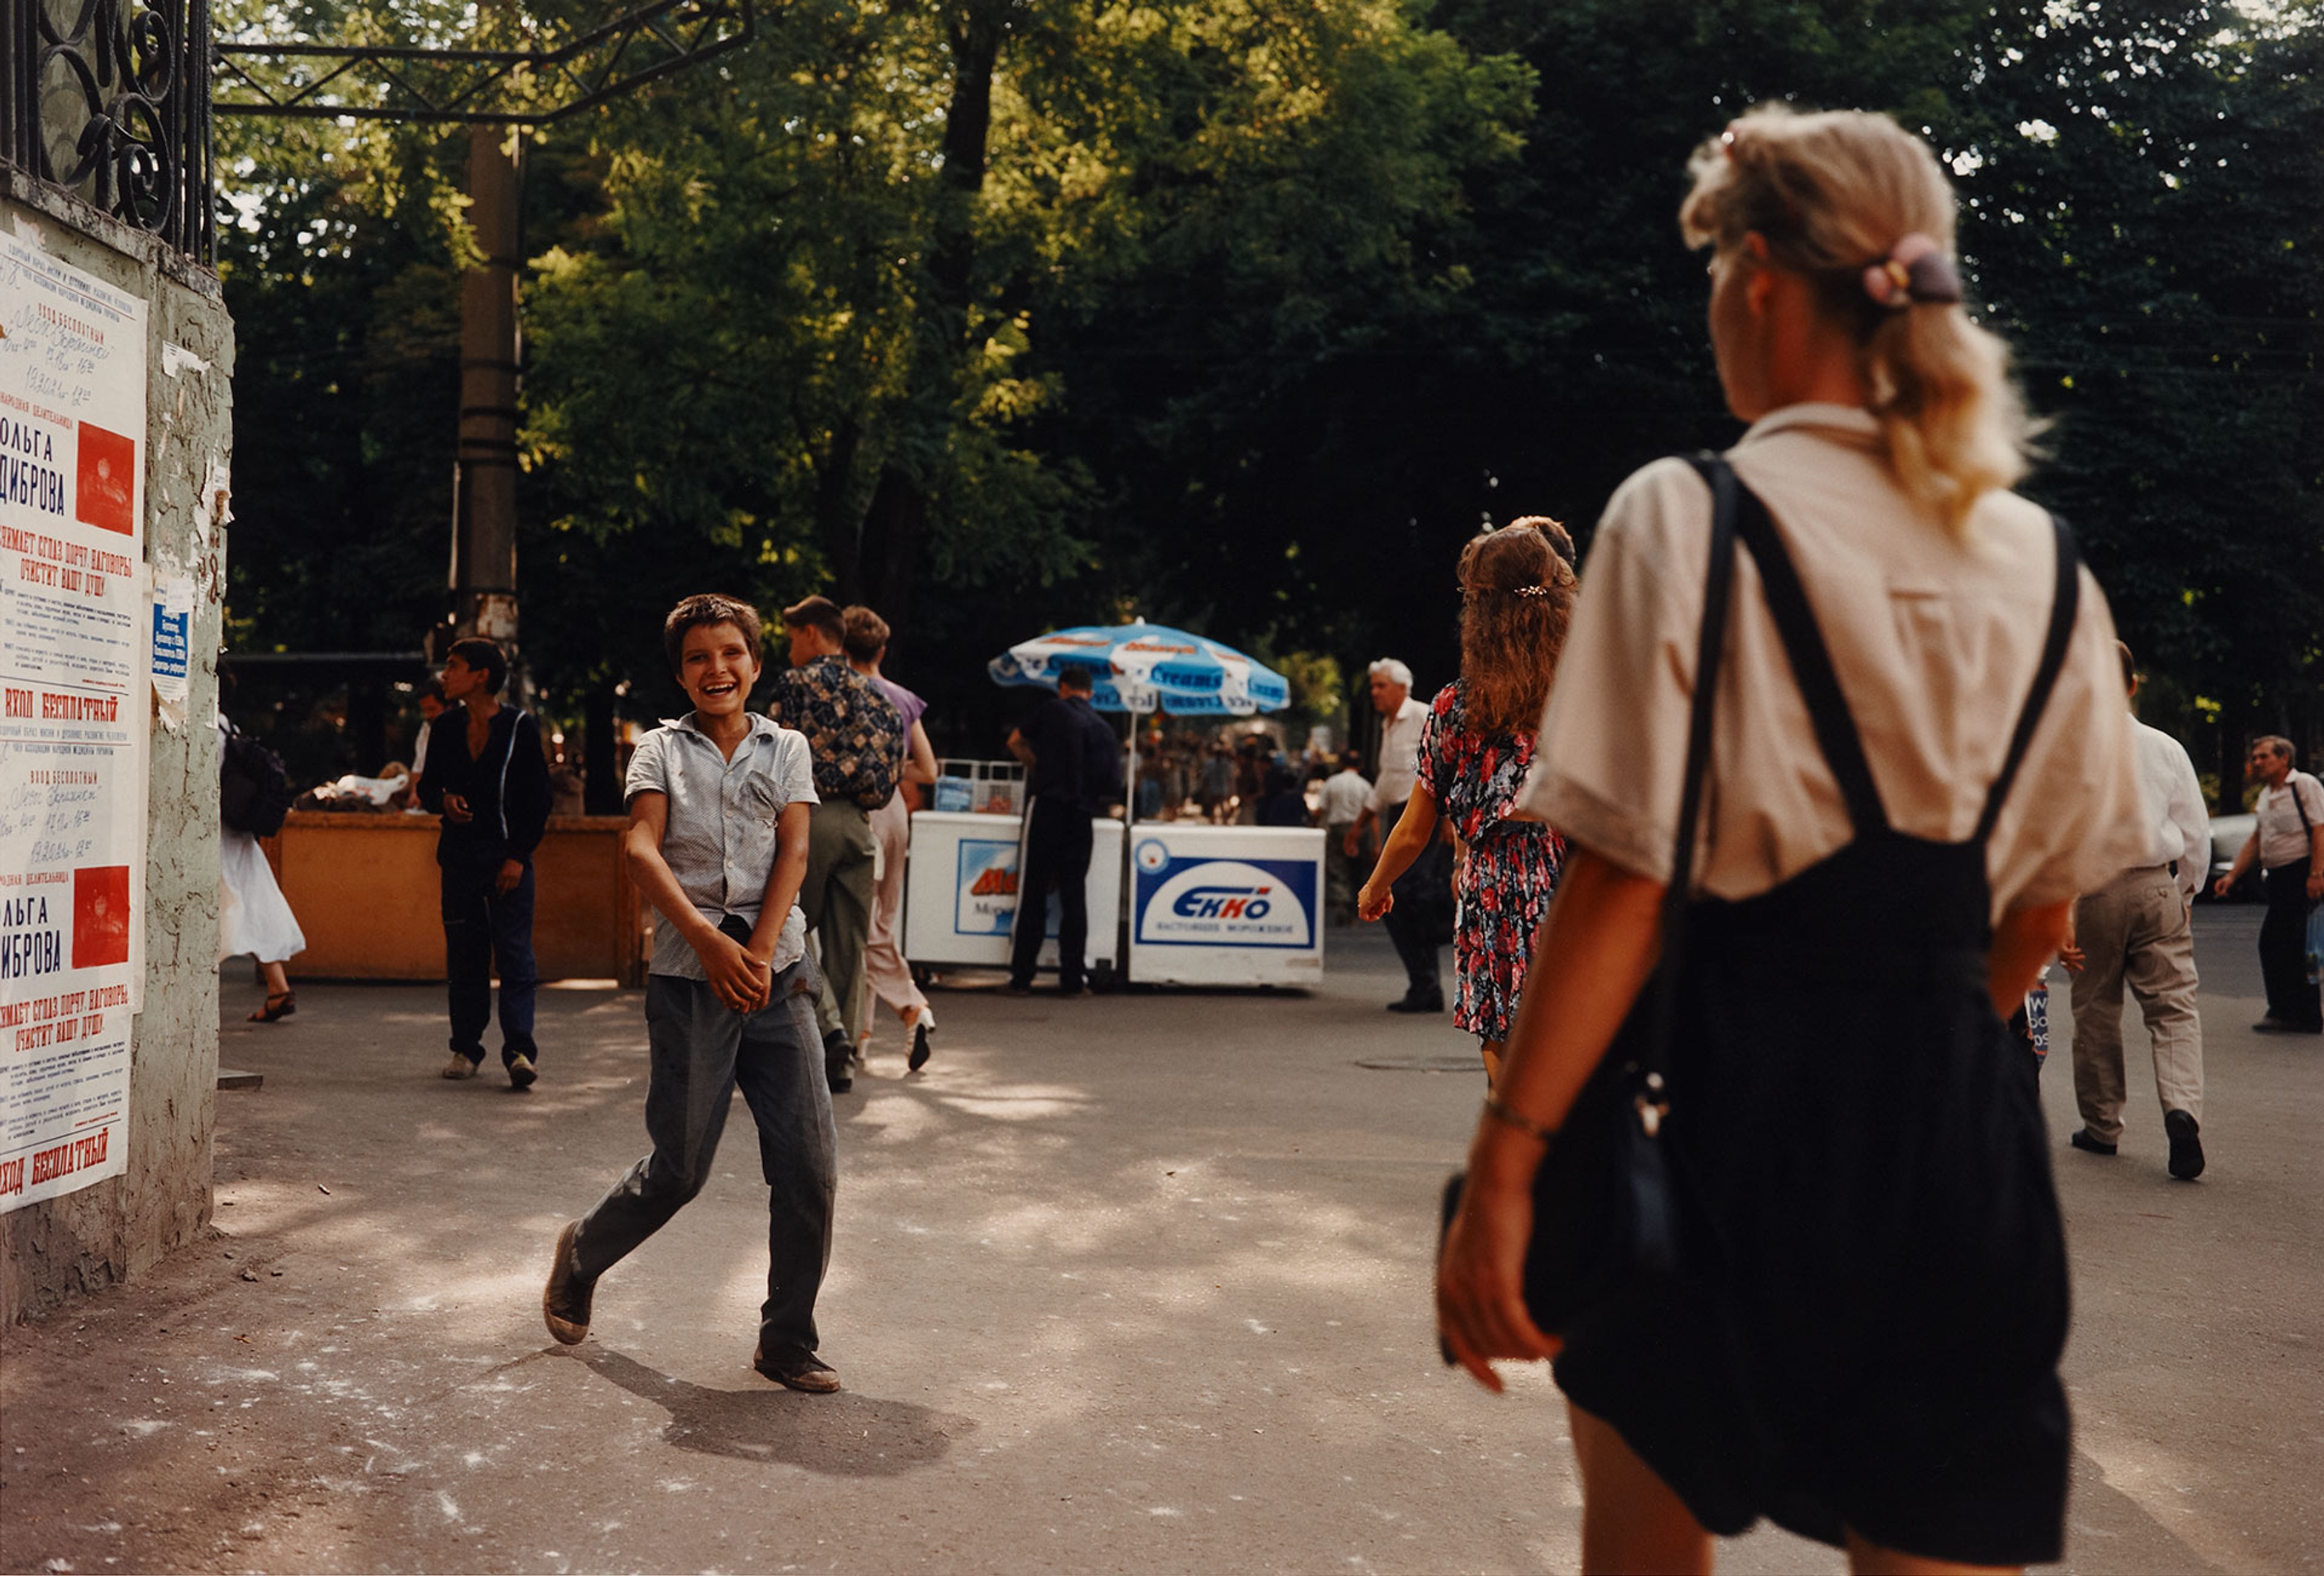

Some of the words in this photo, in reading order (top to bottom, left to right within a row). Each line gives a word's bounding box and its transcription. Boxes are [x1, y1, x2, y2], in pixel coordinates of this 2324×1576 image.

[38, 303, 56, 325] ВХОД
[59, 312, 104, 345] БЕСПЛАТНЫЙ
[0, 417, 52, 462] ОЛЬГА
[0, 454, 65, 516] ДИБРОВА
[62, 568, 82, 592] ВАШУ
[5, 688, 34, 718] ВХОД
[42, 692, 118, 722] БЕСПЛАТНЫЙ
[30, 769, 50, 785] ВХОД
[53, 770, 98, 784] БЕСПЛАТНЫЙ
[15, 1023, 53, 1052] ОЧИСТИТ
[56, 1018, 78, 1043] ВАШУ
[31, 1127, 109, 1186] БЕСПЛАТНЫЙ
